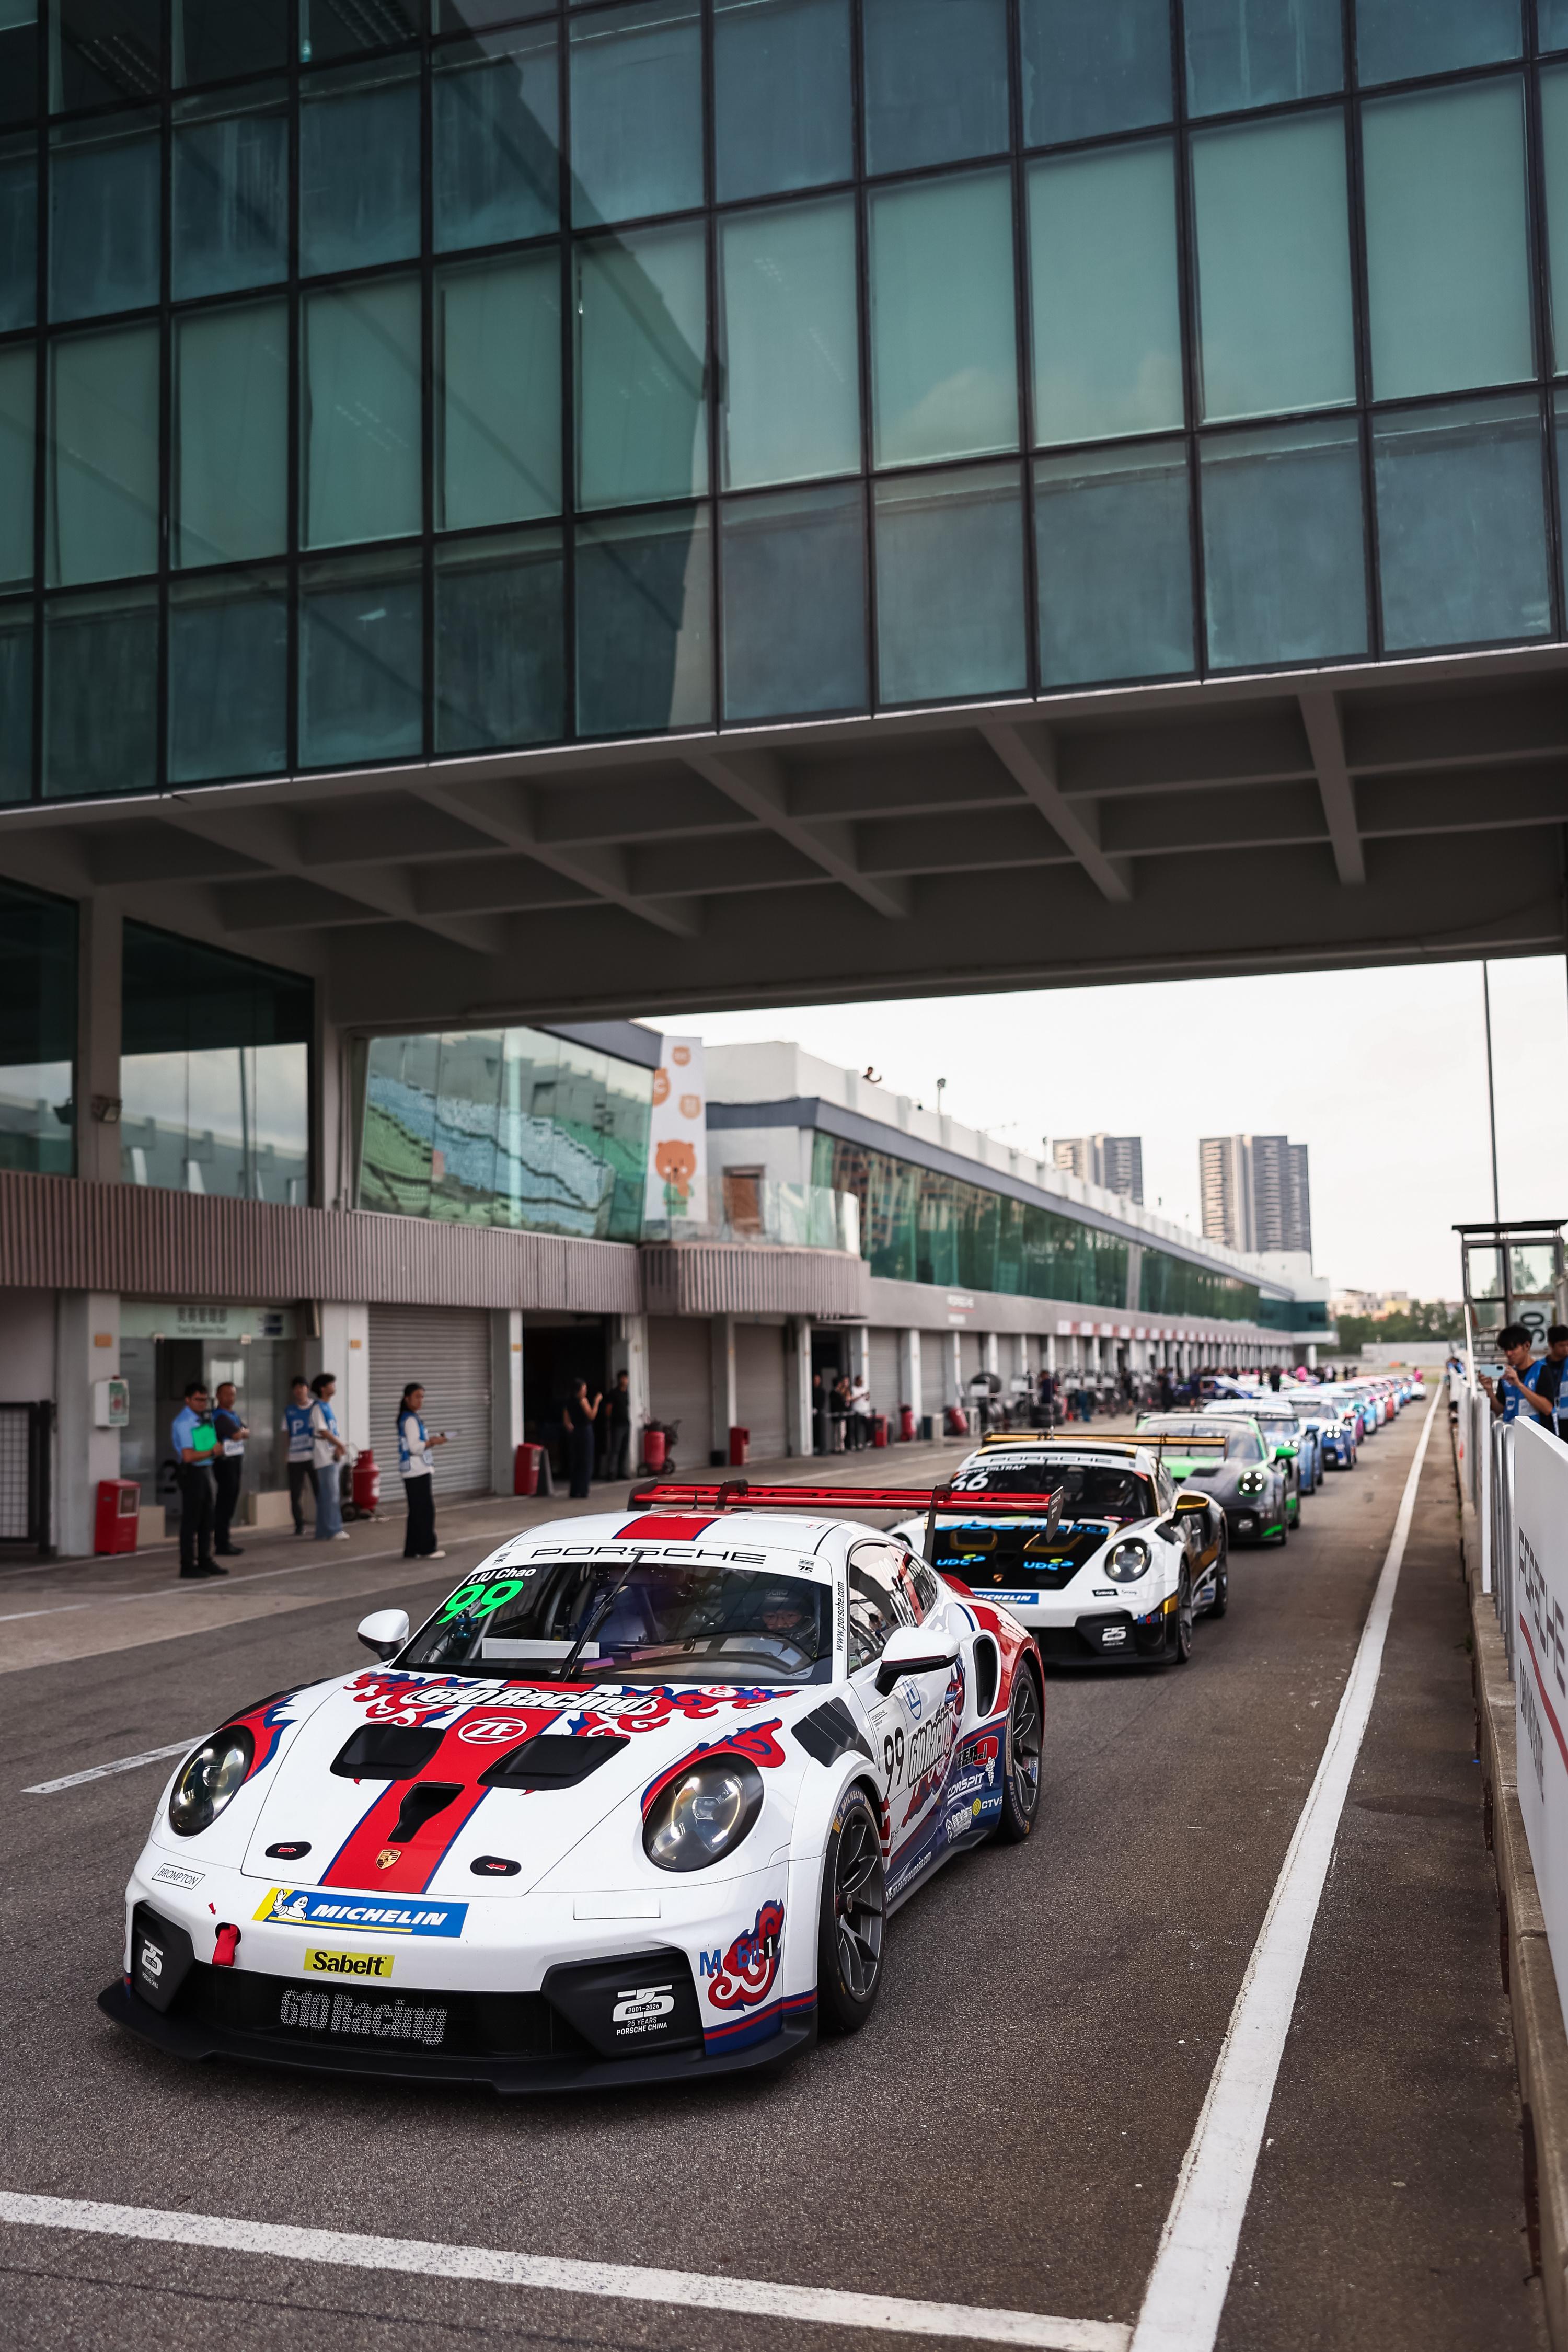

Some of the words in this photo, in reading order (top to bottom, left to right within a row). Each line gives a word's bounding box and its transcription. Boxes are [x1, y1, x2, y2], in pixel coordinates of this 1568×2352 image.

[951, 1471, 989, 1491] 66
[530, 1547, 767, 1564] PORSCHE
[936, 1558, 971, 1566] UDC
[1023, 1561, 1059, 1570] UDC
[467, 1571, 497, 1585] LIU
[495, 1568, 537, 1579] Chao
[436, 1580, 524, 1625] 99
[1519, 1526, 1565, 1698] PORSCHE
[835, 1581, 846, 1652] www.porsche.com
[417, 1688, 500, 1705] 610
[482, 1688, 650, 1713] Racing
[463, 1721, 524, 1739] ZF
[884, 1727, 904, 1795] 99
[947, 1772, 985, 1799] CONSPIT
[840, 1790, 864, 1814] MICHELIN
[157, 1867, 199, 1885] BROMPTON
[310, 1904, 448, 1926] MICHELIN
[312, 1951, 387, 1976] Sabelt
[699, 1939, 759, 1976] Mbil
[613, 1984, 674, 2022] 25
[280, 1989, 330, 2031] 610
[330, 1993, 448, 2045] Racing
[616, 2025, 647, 2036] PORSCHE
[648, 2022, 667, 2031] CHINA
[637, 2016, 657, 2026] YEARS
